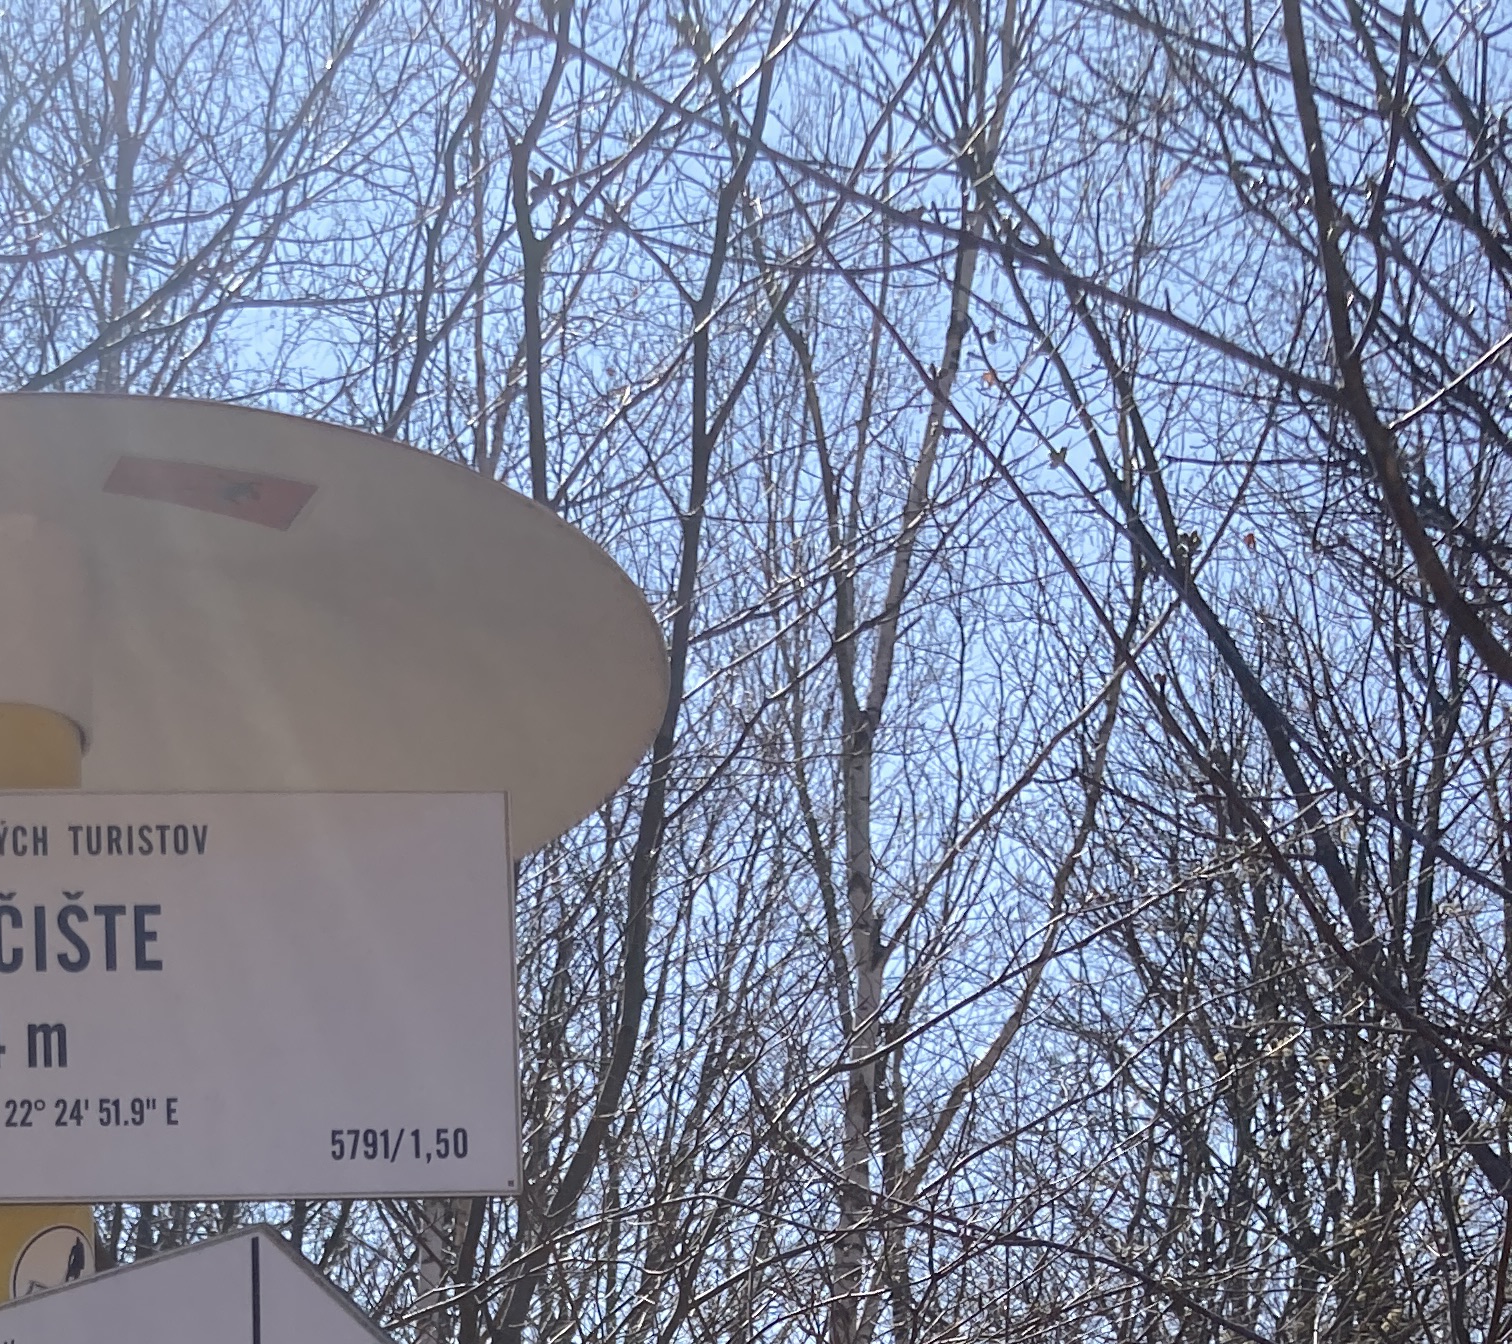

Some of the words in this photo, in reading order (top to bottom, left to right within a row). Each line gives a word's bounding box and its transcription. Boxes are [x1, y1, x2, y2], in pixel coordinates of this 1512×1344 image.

[67, 823, 208, 856] TURISTOV
[26, 1022, 68, 1069] m
[165, 1097, 179, 1126] E
[330, 1127, 469, 1164] 5791/1,50
